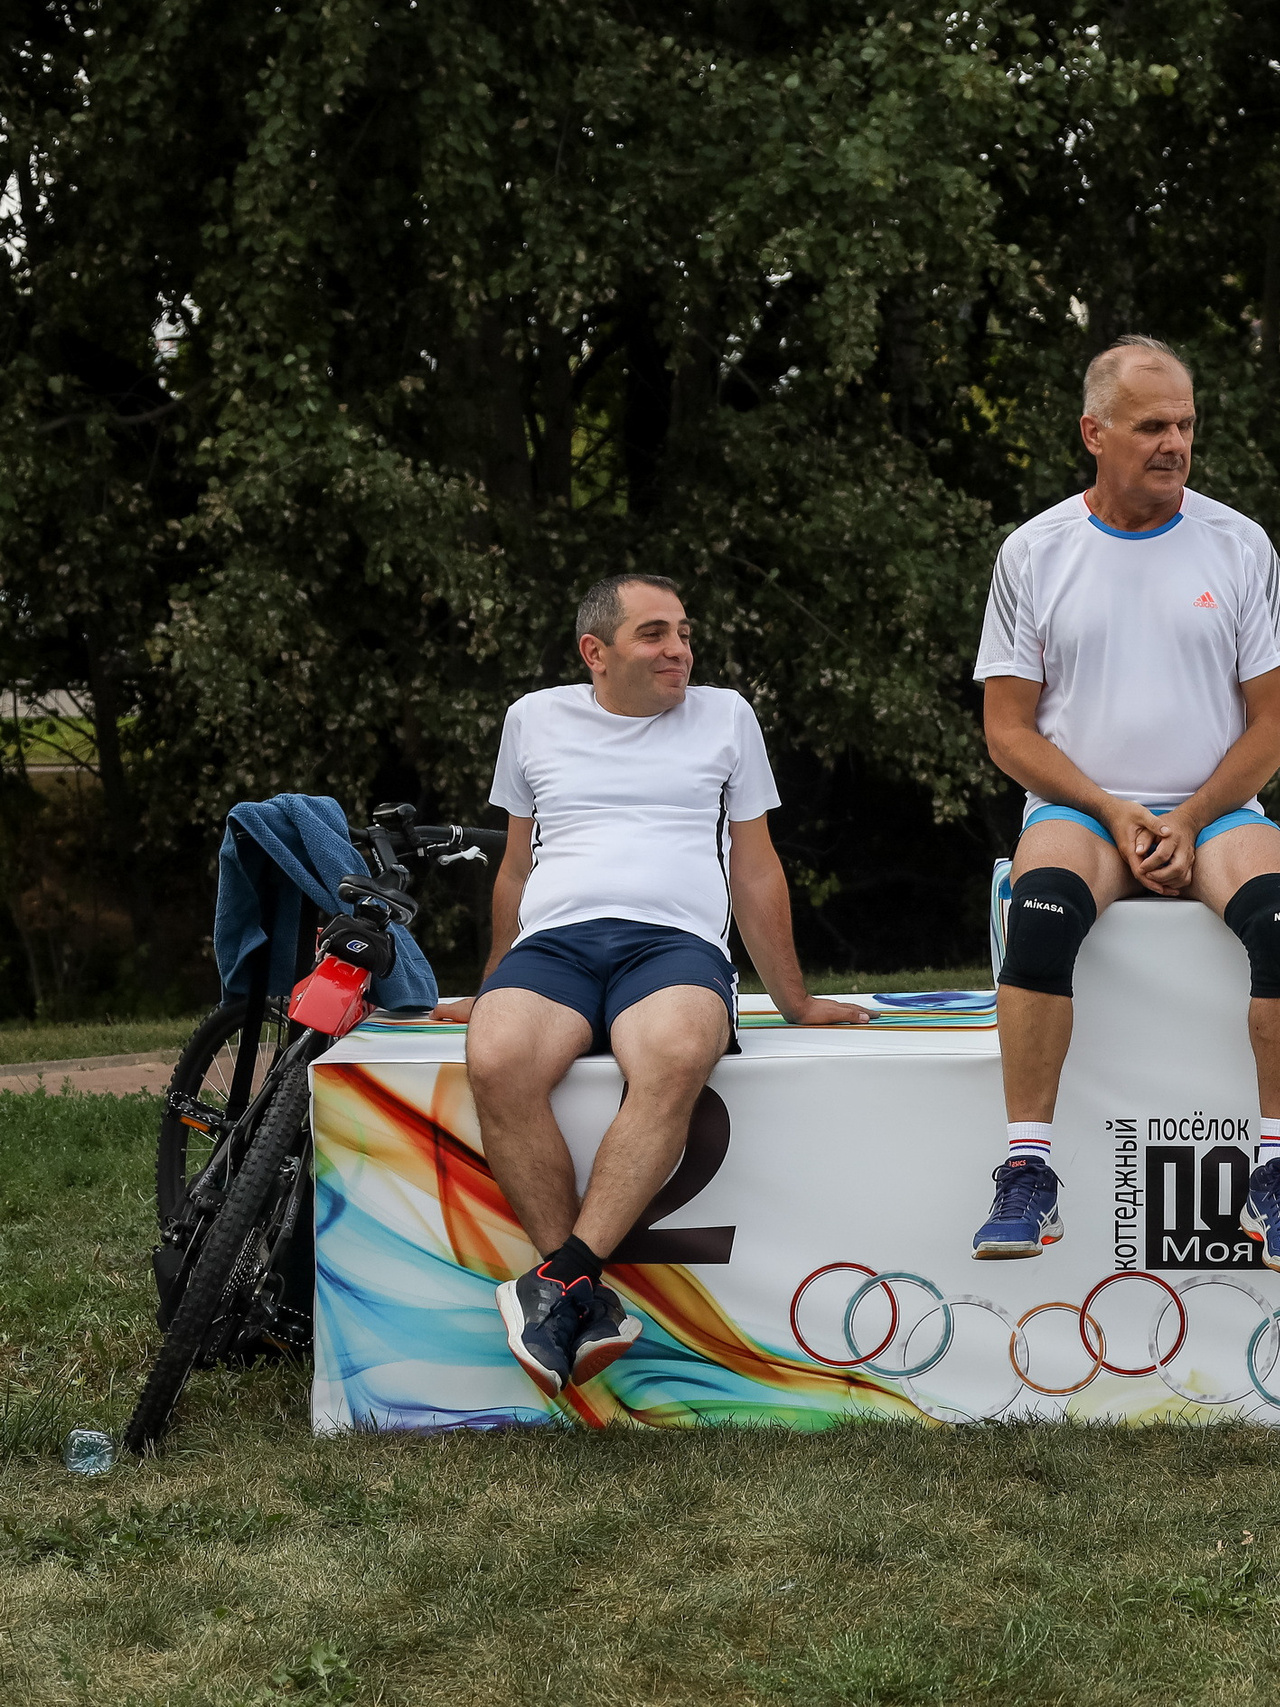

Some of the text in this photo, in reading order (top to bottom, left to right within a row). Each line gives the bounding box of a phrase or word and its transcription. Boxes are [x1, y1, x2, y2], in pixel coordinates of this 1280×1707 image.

[1148, 1111, 1250, 1141] посёлок
[602, 1081, 737, 1264] 2
[1106, 1117, 1144, 1271] коттеджный
[1162, 1236, 1253, 1262] Моя
